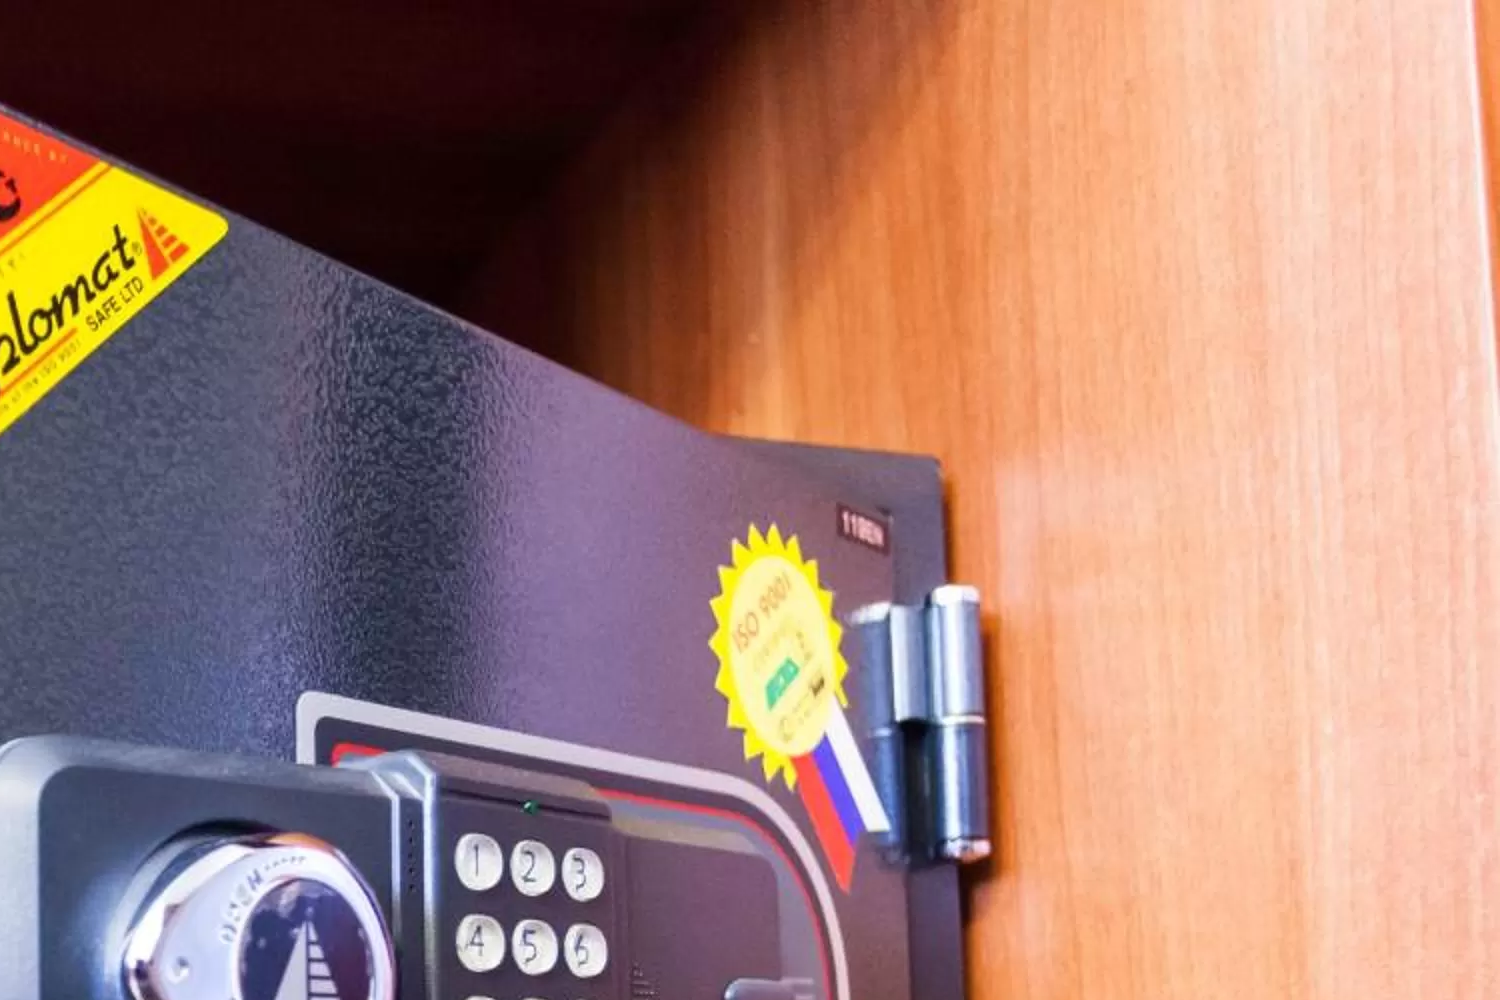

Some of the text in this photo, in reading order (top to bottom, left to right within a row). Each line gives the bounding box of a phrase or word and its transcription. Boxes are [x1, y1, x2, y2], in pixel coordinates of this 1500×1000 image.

[85, 277, 145, 333] SAFE LTD
[732, 614, 760, 653] ISO
[759, 571, 792, 620] 9001
[521, 849, 537, 884] 2
[573, 855, 587, 892] 3
[469, 924, 589, 969] 4 5 6
